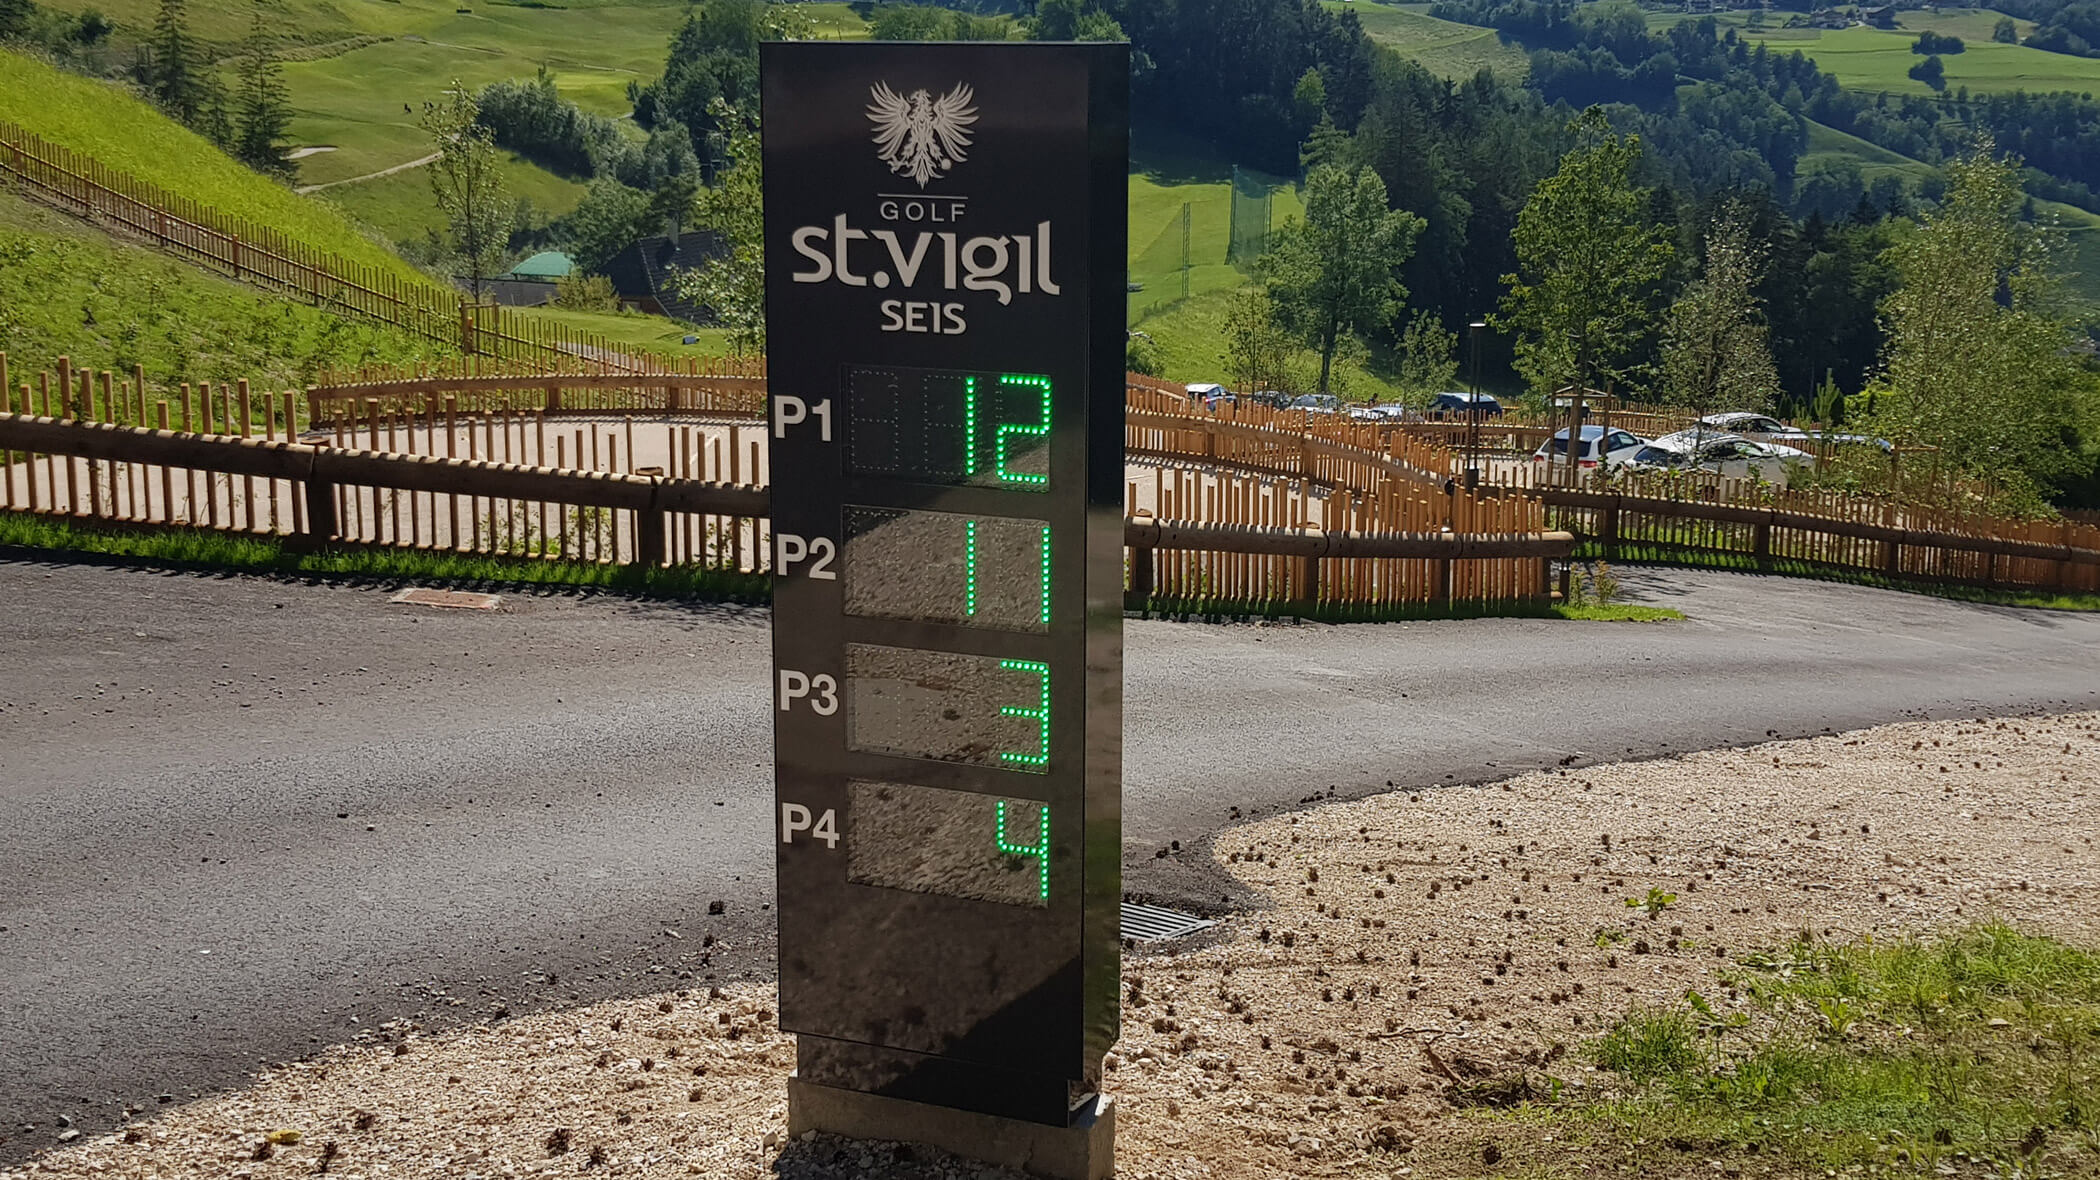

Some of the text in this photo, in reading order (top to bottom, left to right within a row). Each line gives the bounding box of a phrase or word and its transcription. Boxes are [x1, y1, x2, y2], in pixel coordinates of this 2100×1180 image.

[880, 202, 967, 222] GOLF
[880, 300, 967, 335] SEIS
[774, 395, 833, 442] P1
[966, 376, 1051, 485] 12
[776, 533, 837, 581] P2
[966, 520, 1051, 624] 11
[779, 669, 839, 717] P3
[1000, 659, 1050, 766] 3
[781, 802, 841, 849] P4
[997, 801, 1050, 898] 4
